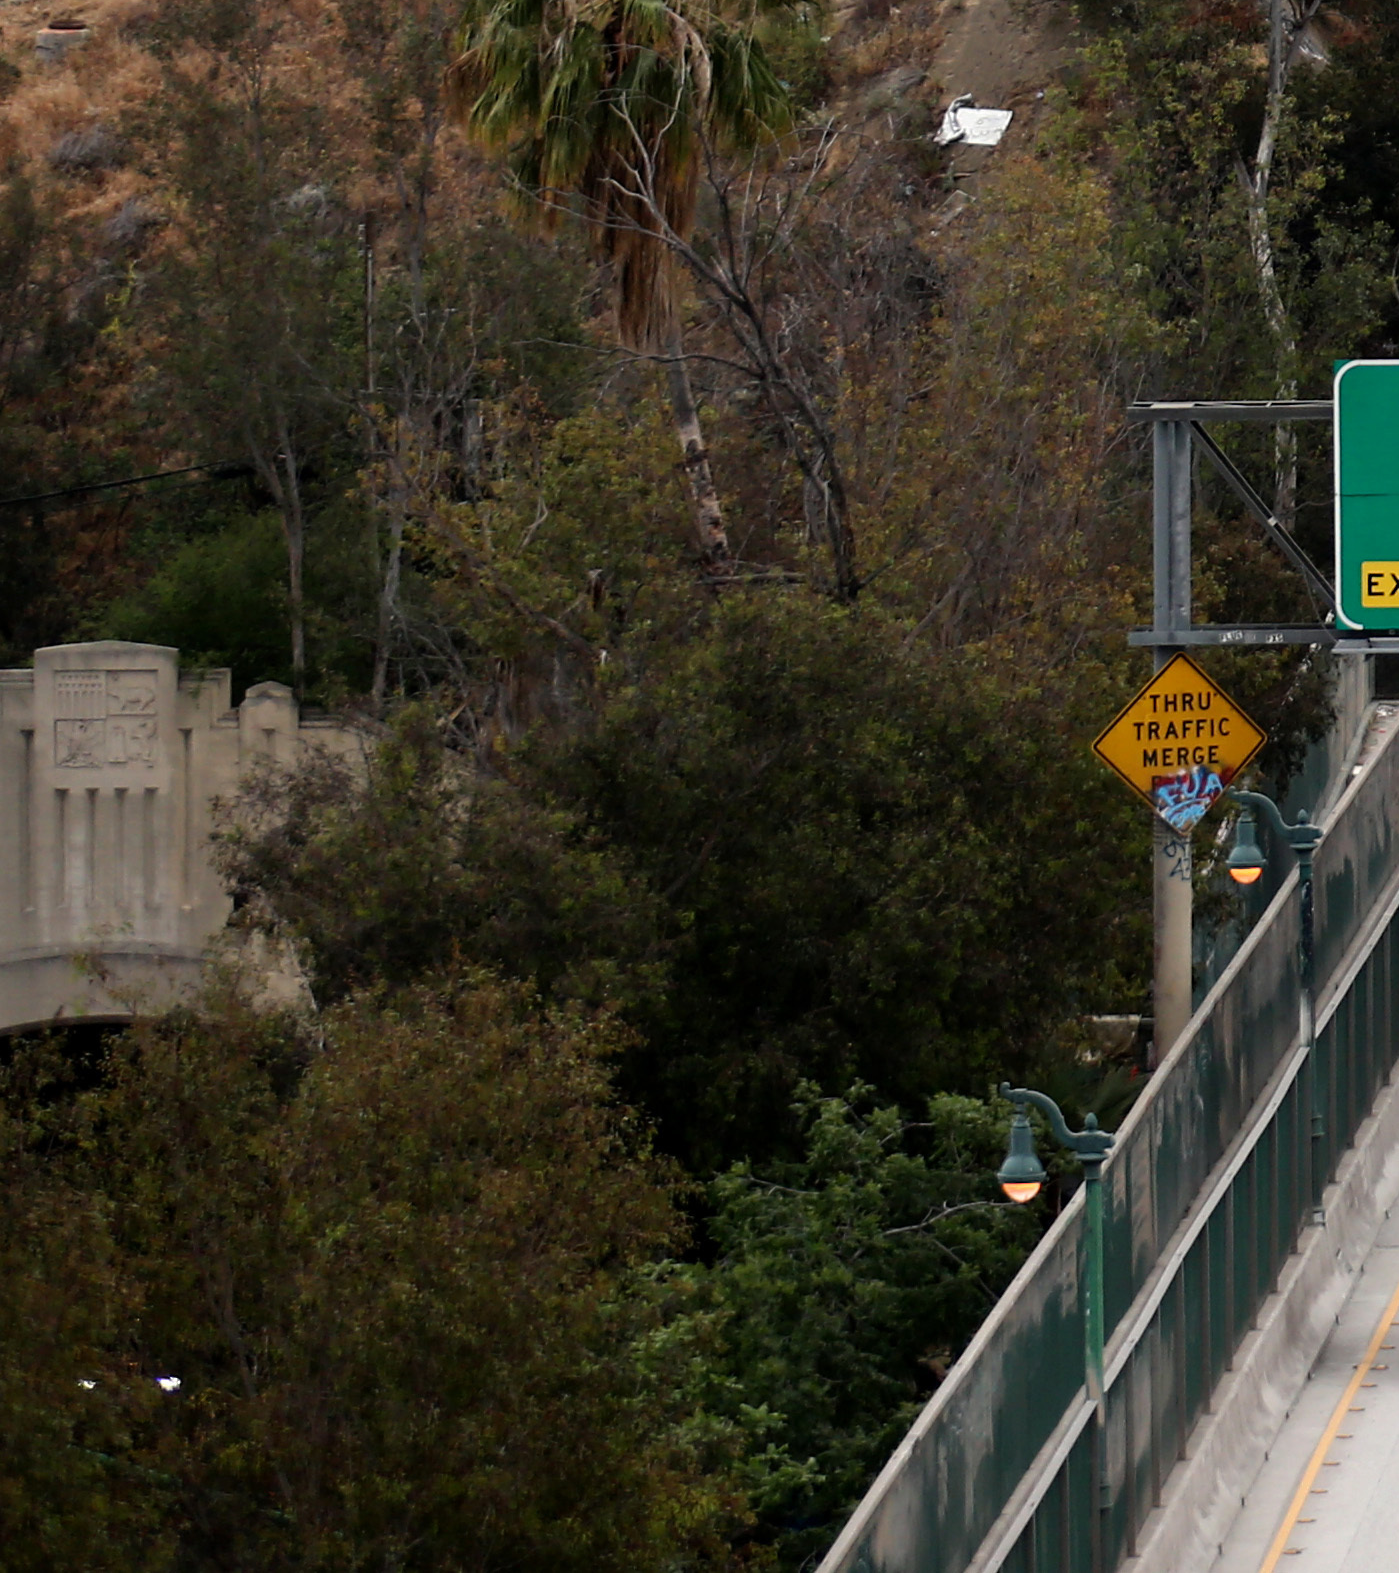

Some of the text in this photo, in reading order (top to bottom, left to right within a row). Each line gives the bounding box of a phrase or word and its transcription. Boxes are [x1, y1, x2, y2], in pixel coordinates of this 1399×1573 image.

[1150, 692, 1211, 713] THRU
[1134, 717, 1230, 740] TRAFFIC
[1143, 745, 1219, 767] MERGE
